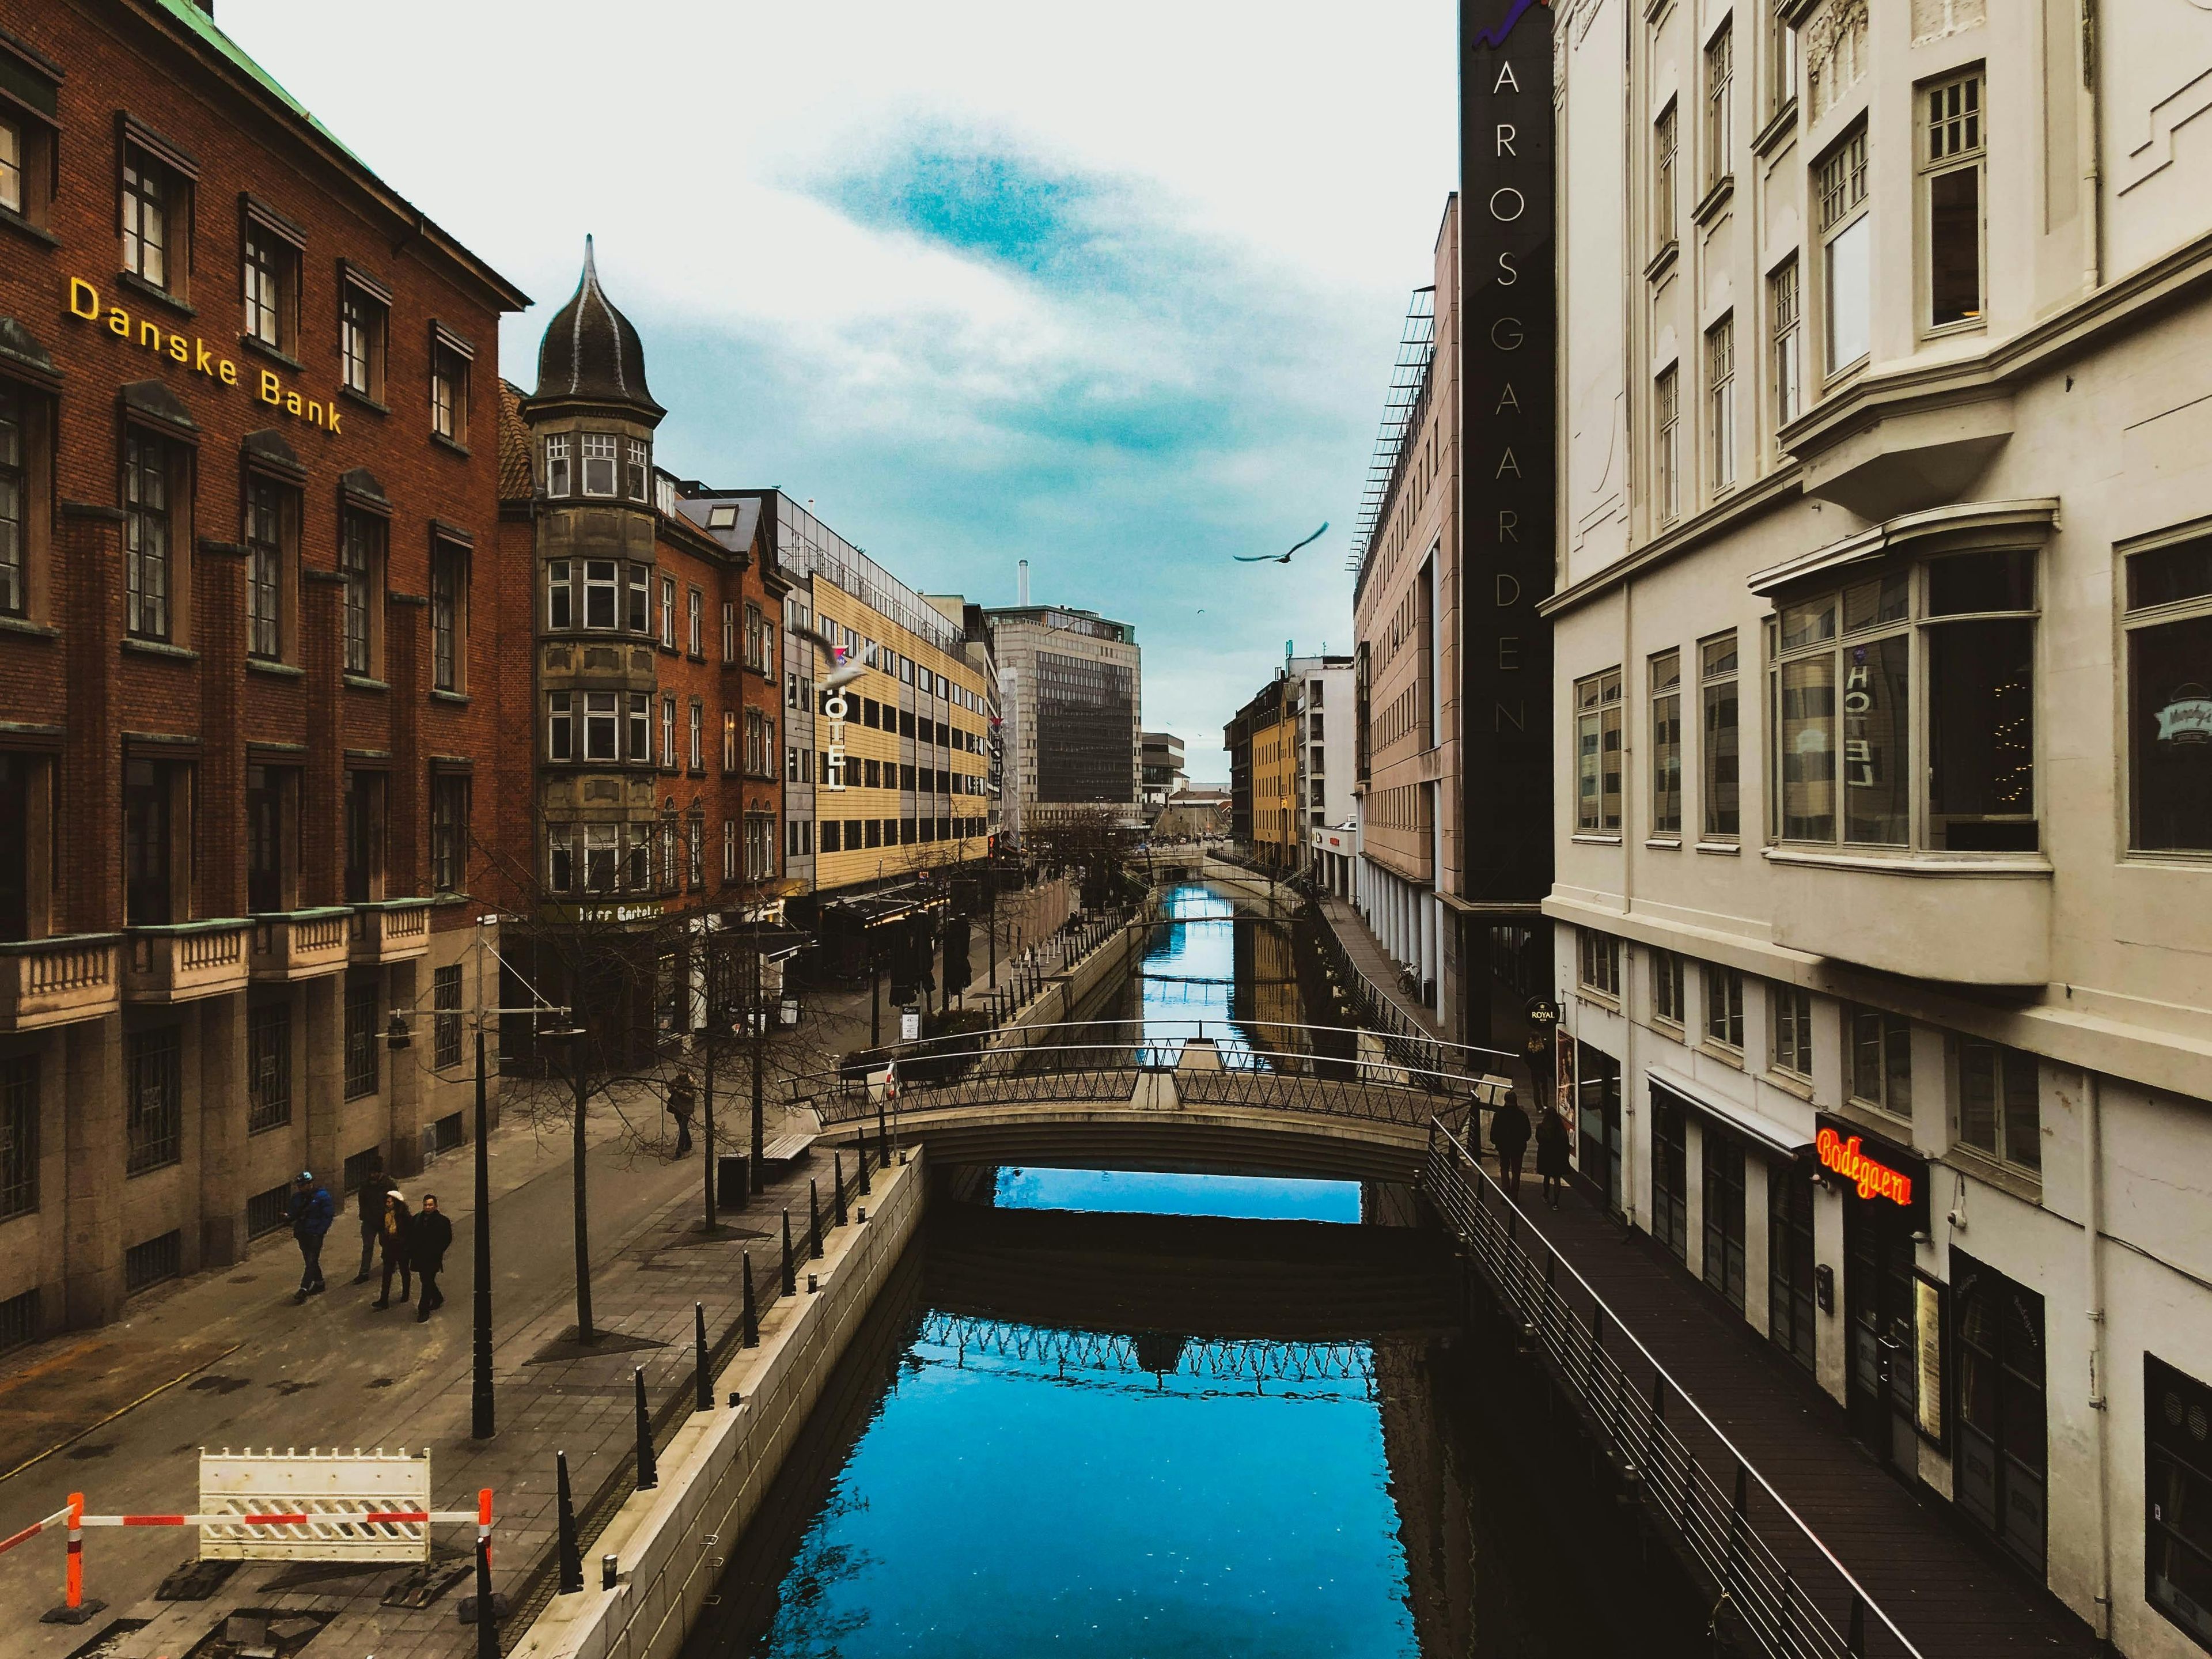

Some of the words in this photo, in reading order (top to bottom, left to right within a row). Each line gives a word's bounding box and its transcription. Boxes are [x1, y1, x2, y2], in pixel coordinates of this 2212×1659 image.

[70, 276, 238, 386] Danske
[260, 369, 342, 435] Bank
[1490, 60, 1525, 733] AROSGAARDEN
[1816, 1128, 1912, 1206] Bodegaen
